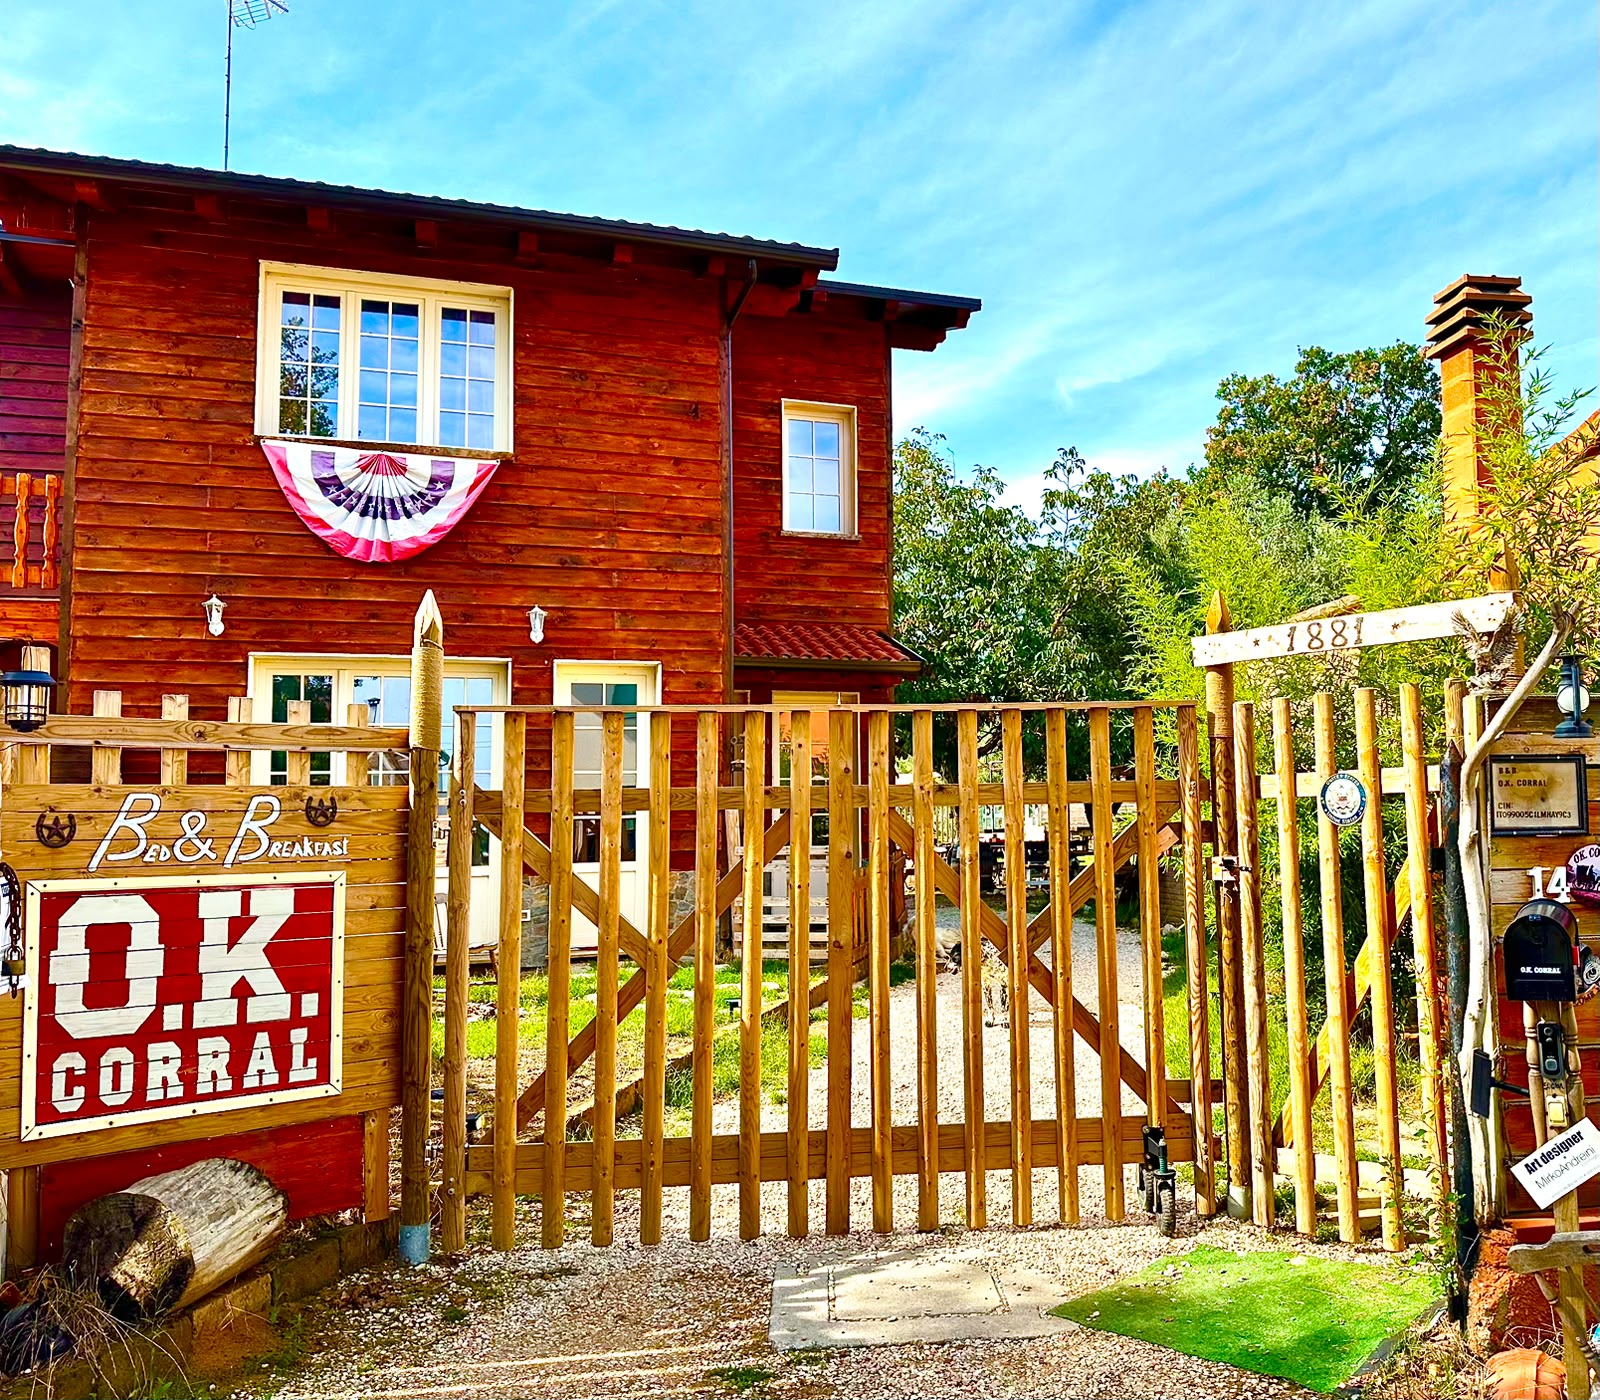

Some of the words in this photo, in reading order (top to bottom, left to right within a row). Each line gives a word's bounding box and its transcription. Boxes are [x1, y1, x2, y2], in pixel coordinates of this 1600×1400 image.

[1286, 617, 1364, 652] 1881
[1516, 779, 1548, 788] CORRAL
[172, 809, 218, 863] &
[1526, 865, 1571, 904] 14
[49, 888, 319, 1040] O.K.
[1534, 966, 1562, 974] CORRAL
[51, 1027, 318, 1114] CORRAL
[1524, 1158, 1543, 1175] Art
[1540, 1130, 1585, 1165] designer
